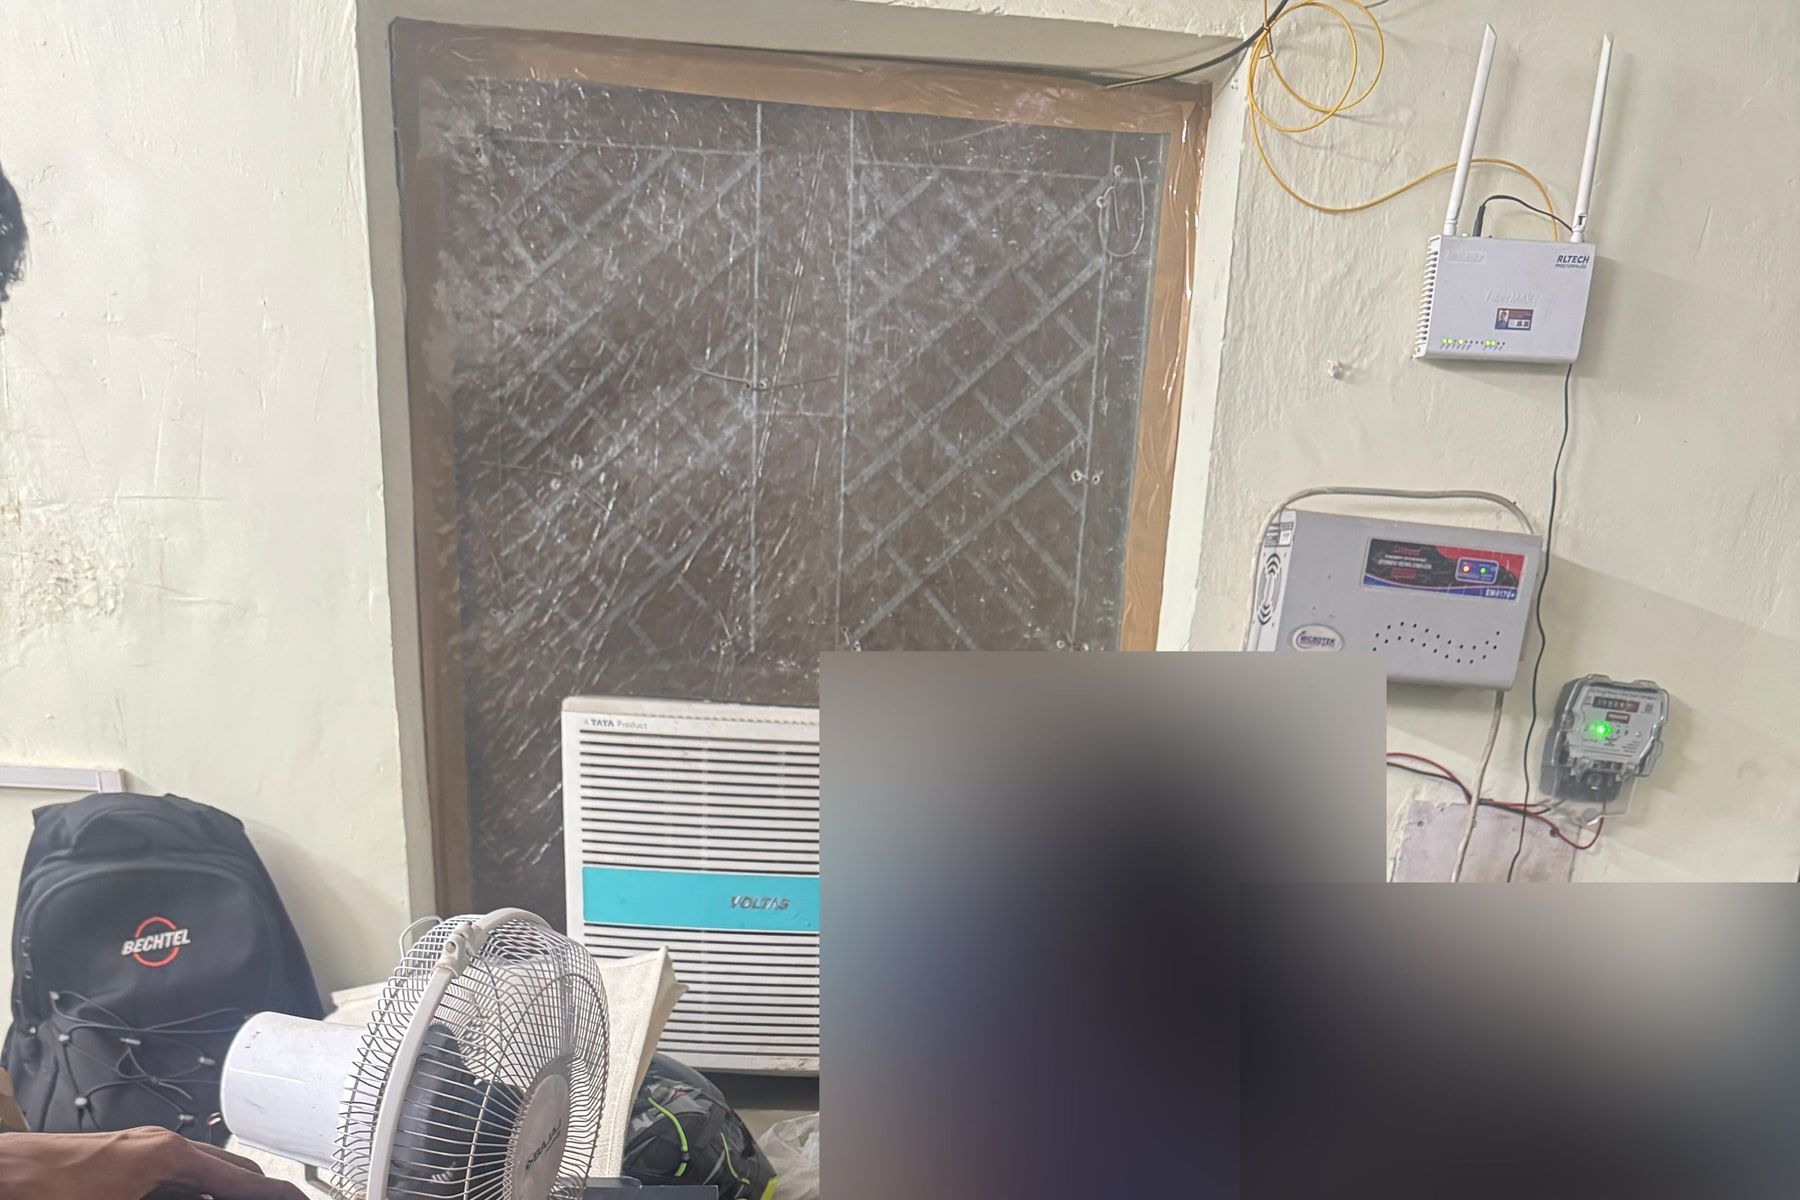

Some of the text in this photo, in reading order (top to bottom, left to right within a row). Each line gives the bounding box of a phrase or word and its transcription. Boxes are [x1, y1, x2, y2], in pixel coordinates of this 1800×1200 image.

[1556, 254, 1590, 264] RLTECH
[591, 718, 614, 728] TATA
[617, 719, 648, 729] Product
[731, 896, 789, 911] VOLTAS
[121, 928, 191, 955] BECHTEL
